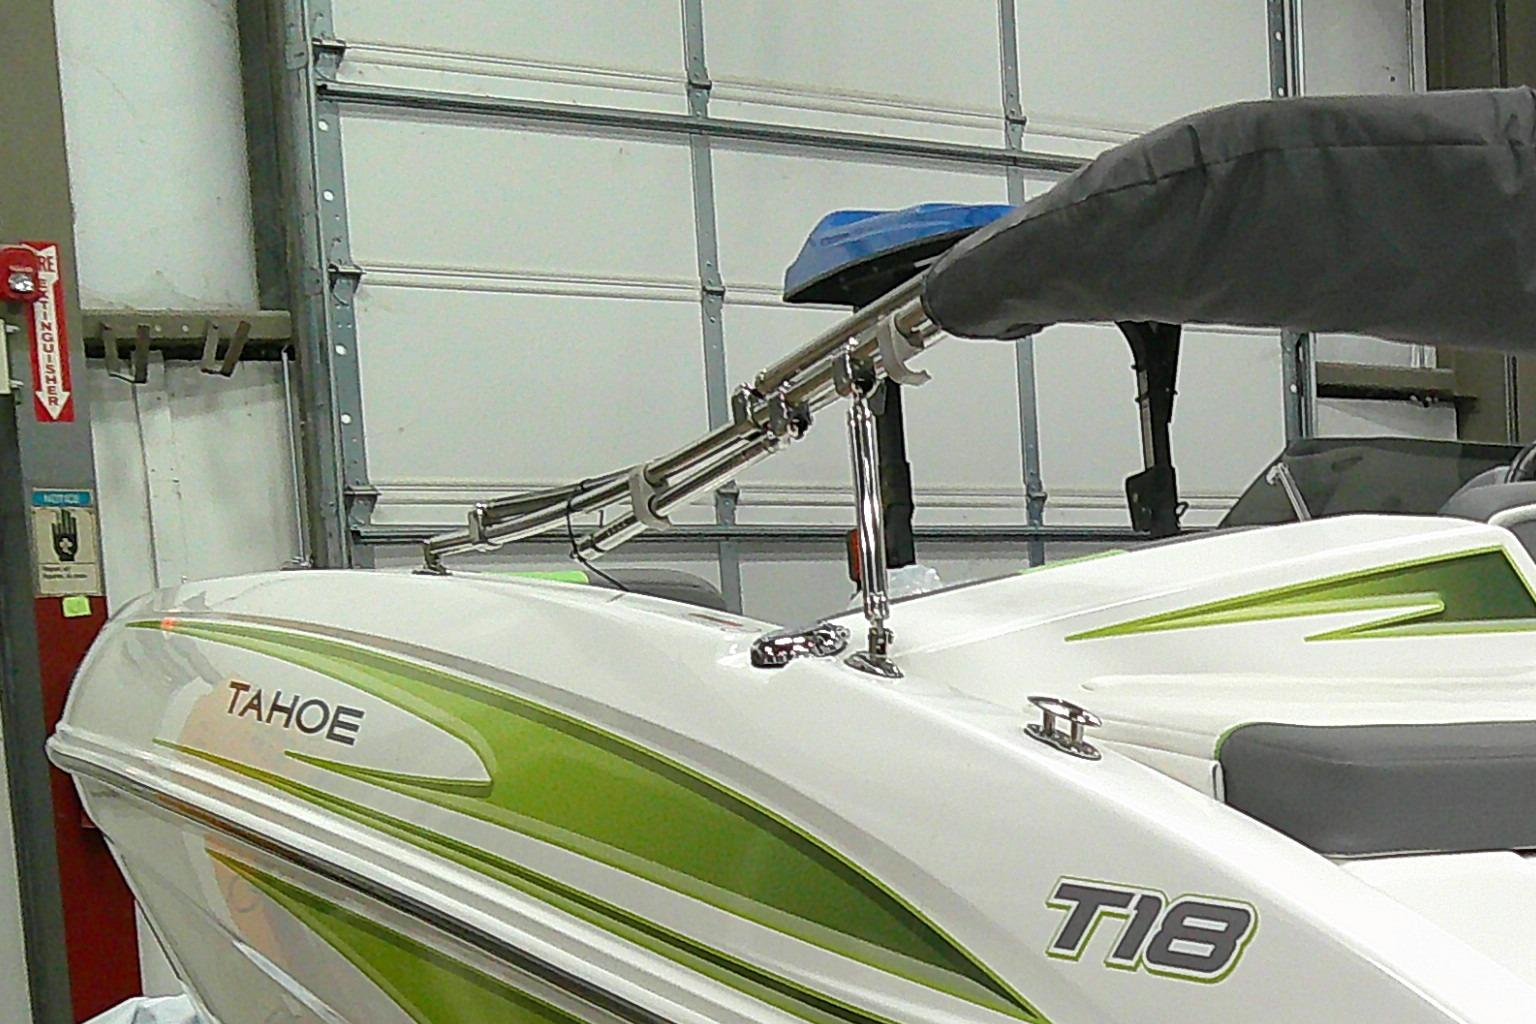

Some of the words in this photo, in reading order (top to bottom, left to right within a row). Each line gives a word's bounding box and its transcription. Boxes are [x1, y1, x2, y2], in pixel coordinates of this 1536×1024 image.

[39, 278, 59, 406] EXTINGUISHER
[227, 680, 365, 747] TAHOE
[1046, 876, 1259, 985] T18
